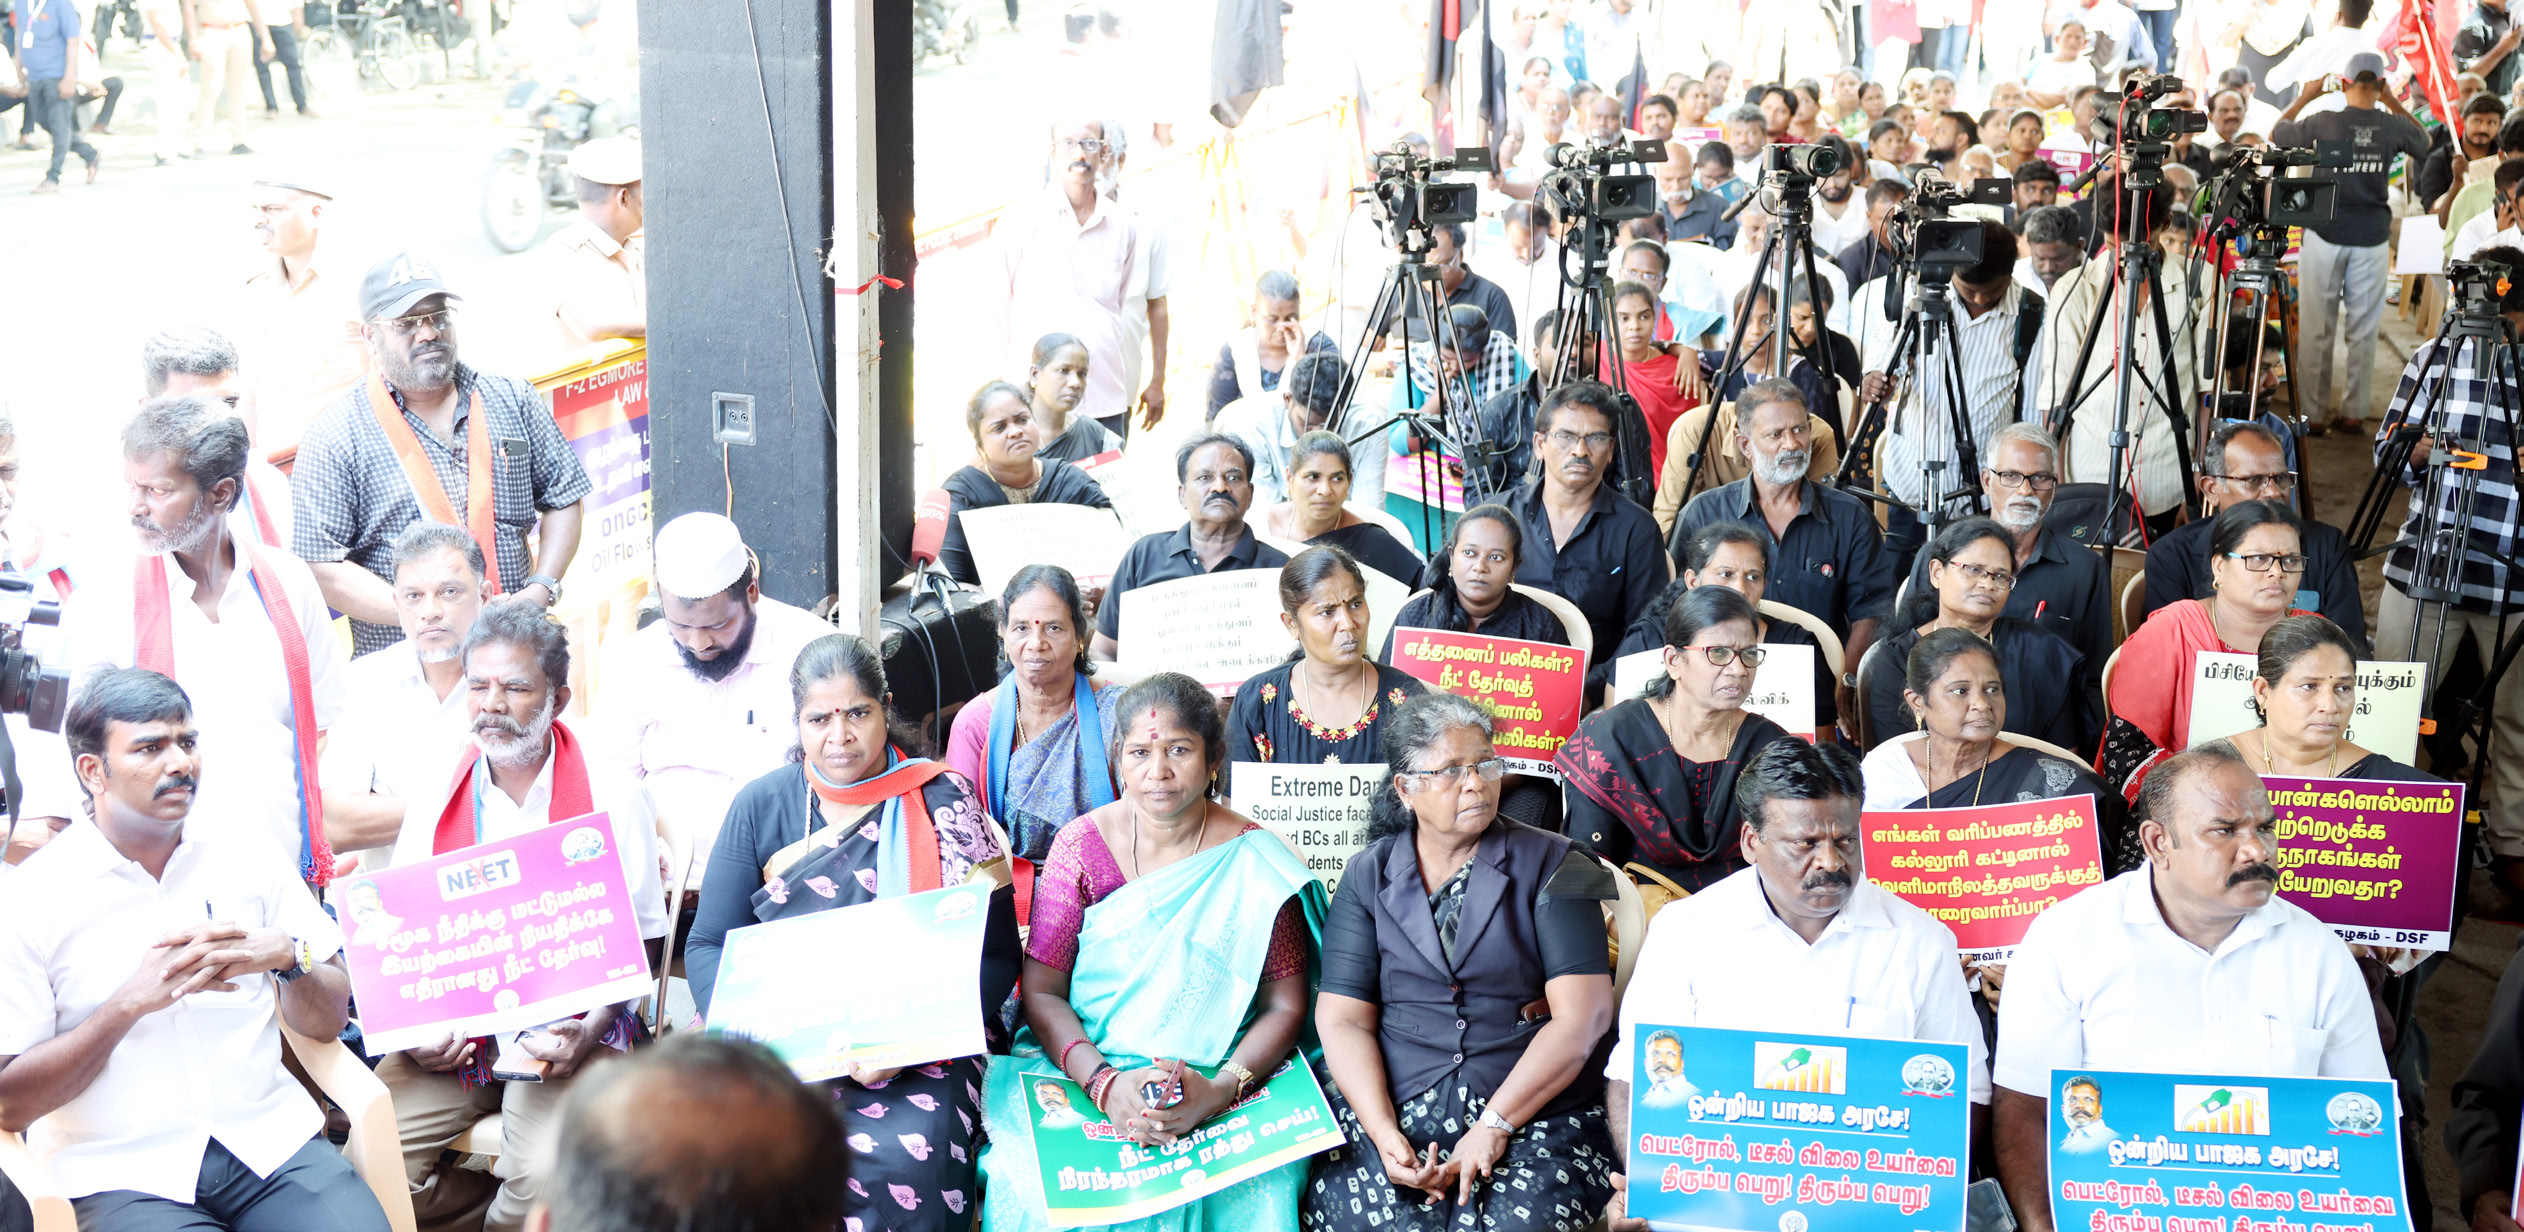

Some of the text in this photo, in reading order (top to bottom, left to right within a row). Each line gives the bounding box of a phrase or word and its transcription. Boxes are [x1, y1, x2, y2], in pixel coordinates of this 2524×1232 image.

[614, 382, 642, 408] LAW
[1404, 636, 1574, 674] எத்தனைப் பலிகள்?
[1438, 664, 1534, 698] நீட் தேர்வுத்
[1271, 775, 1381, 797] Extreme Dan
[2268, 782, 2455, 814] யான்களெல்லாம்
[1252, 804, 1292, 821] Social
[1296, 805, 1343, 822] Justice
[1872, 809, 2084, 843] எங்கள் வரிப்பணத்தில்
[1302, 830, 1329, 846] BCs
[1333, 830, 1348, 846] all
[1890, 837, 2071, 873] கல்லூரி கட்டினால்
[1308, 854, 1343, 871] dents
[2276, 842, 2402, 870] நாகங்கள்
[446, 858, 511, 893] NEET
[2272, 869, 2403, 901] யேறுவதா?
[437, 908, 507, 944] நீதிக்கு
[511, 881, 607, 918] மட்டுமல்ல
[380, 906, 615, 977] இயற்கையின் நியதிக்கே
[2395, 931, 2429, 945] DSF
[399, 935, 607, 1002] எதிரானது நீட் தேர்வு!
[1687, 1090, 1911, 1132] ஒன்றிய பாஜக அரசே!
[1058, 1153, 1193, 1191] நிரந்தரமாக
[1198, 1131, 1256, 1165] ரத்து
[1259, 1105, 1321, 1137] செய்!
[1118, 1144, 1155, 1169] நீட்
[1640, 1133, 1956, 1177] பெட்ரோல், டீசல் விலை உயர்வை
[2107, 1133, 2341, 1172] ஒன்றிய பாஜக அரசே!
[1661, 1163, 1931, 1216] திரும்ப பெறு! திரும்ப பெறு!
[2062, 1178, 2396, 1216] பெட்ரோல், டீசல் விலை உயர்வை
